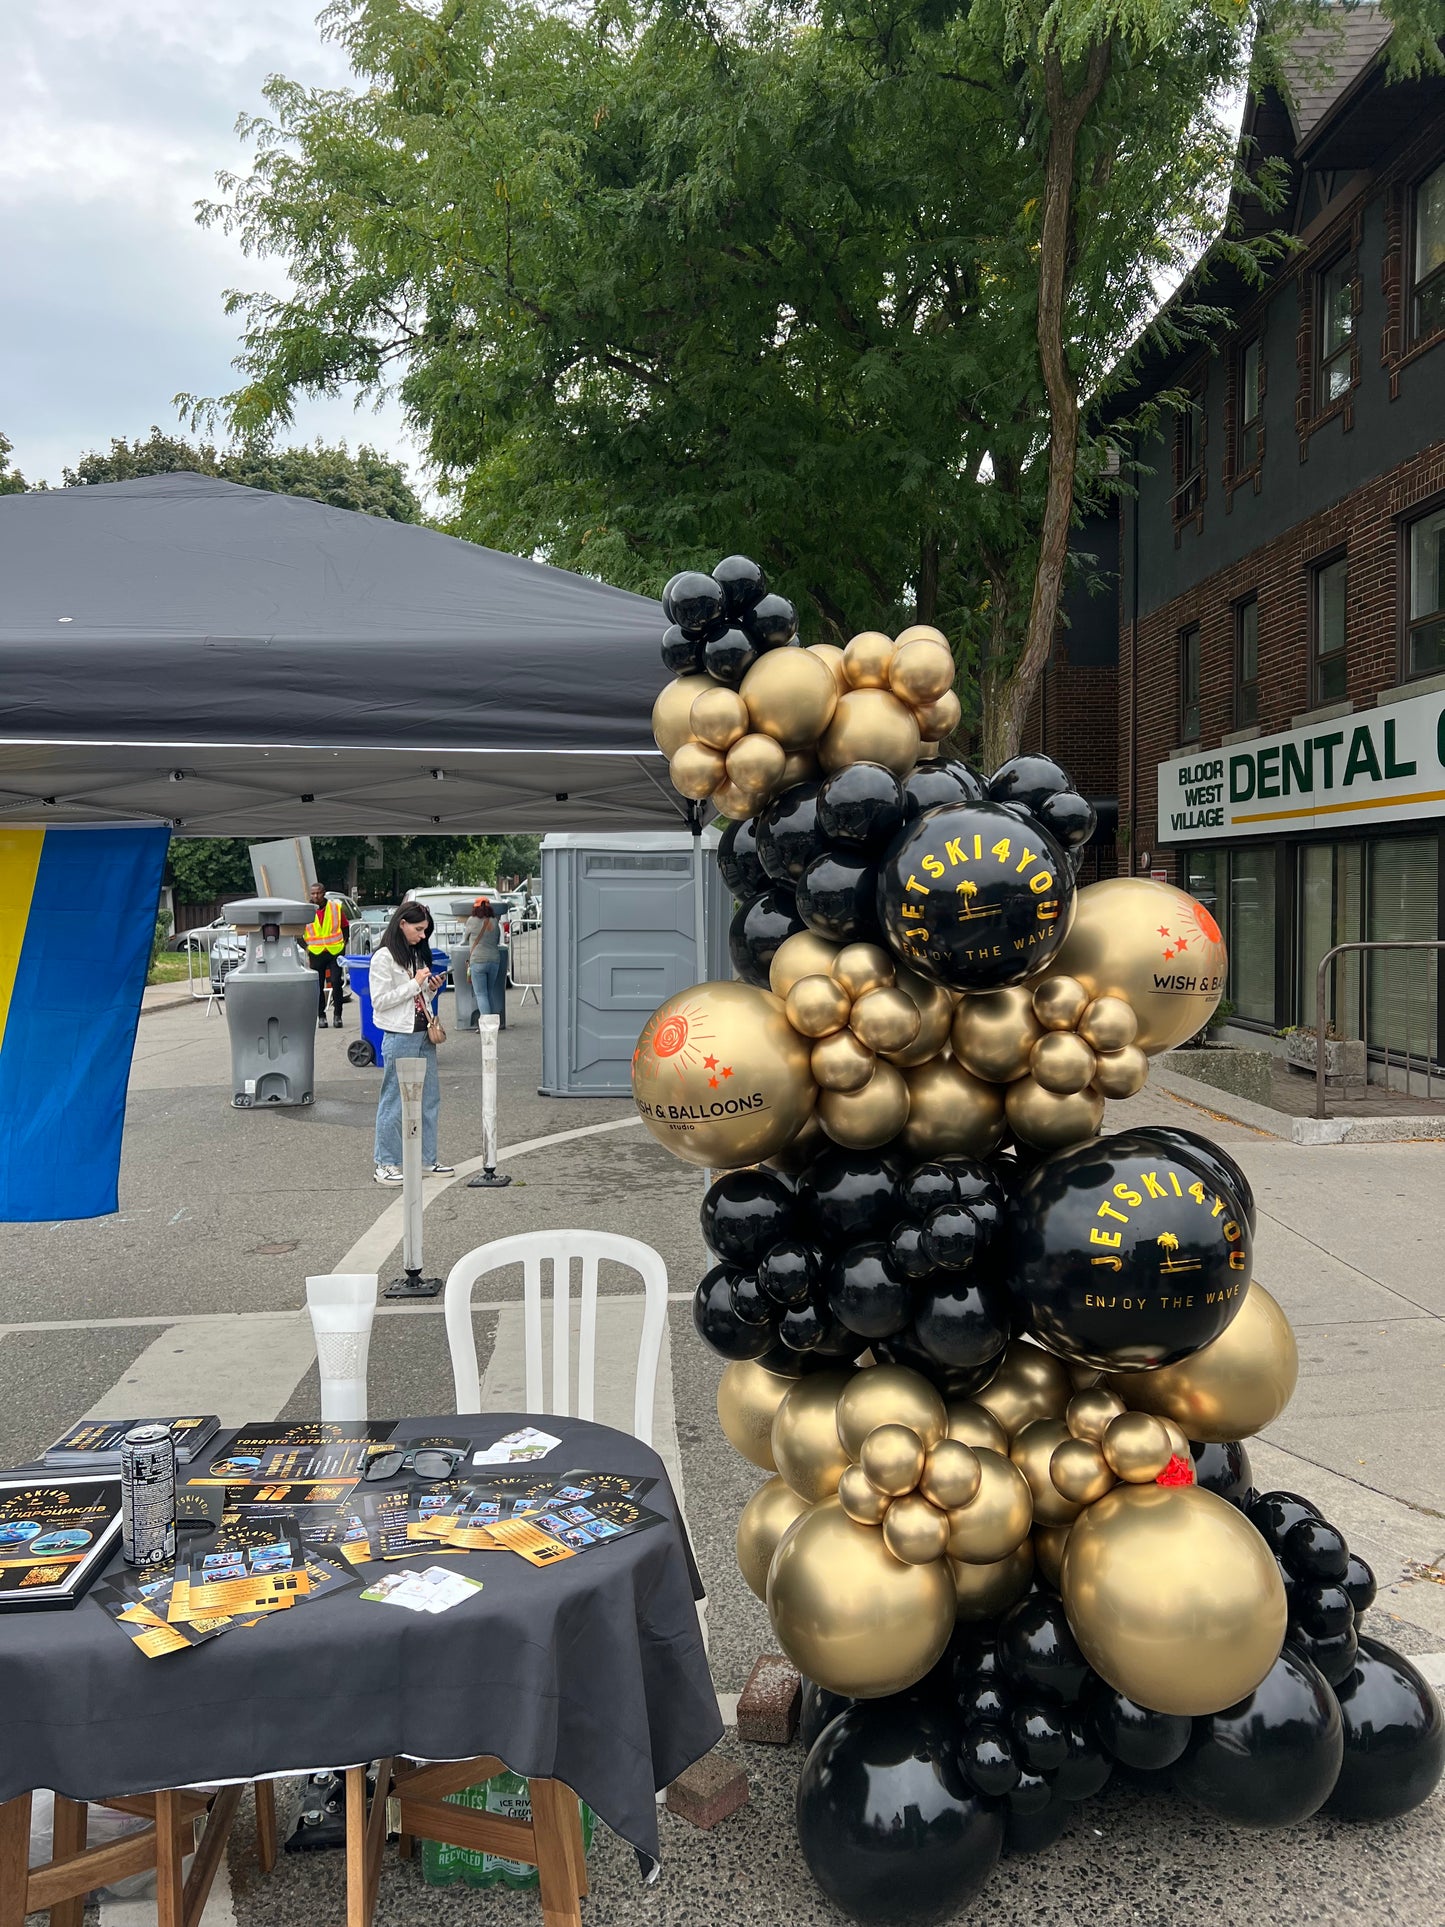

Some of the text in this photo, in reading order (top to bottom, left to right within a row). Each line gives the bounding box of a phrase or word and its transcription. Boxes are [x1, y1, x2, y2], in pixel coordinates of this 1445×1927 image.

[1178, 759, 1224, 786] BLOOR
[1229, 718, 1417, 803] DENTAL
[1185, 783, 1224, 807] WEST
[1170, 807, 1224, 831] VILLAGE
[901, 834, 1059, 942] JETSKI4YOU
[902, 925, 1055, 961] ENJOY THE WAVE
[1153, 974, 1197, 991] WISH
[1200, 977, 1210, 991] &
[655, 1104, 666, 1119] &
[668, 1092, 764, 1119] BALLOONS
[669, 1123, 695, 1131] studio
[1089, 1171, 1246, 1273] JETSKI4YOU
[1085, 1284, 1240, 1310] ENJOY THE WAVE
[9, 1505, 107, 1519] ГІДРОЦИКЛІВ
[376, 1500, 409, 1510] JETSK
[500, 1799, 532, 1807] ICE RIV
[438, 1849, 481, 1867] RECYCLED
